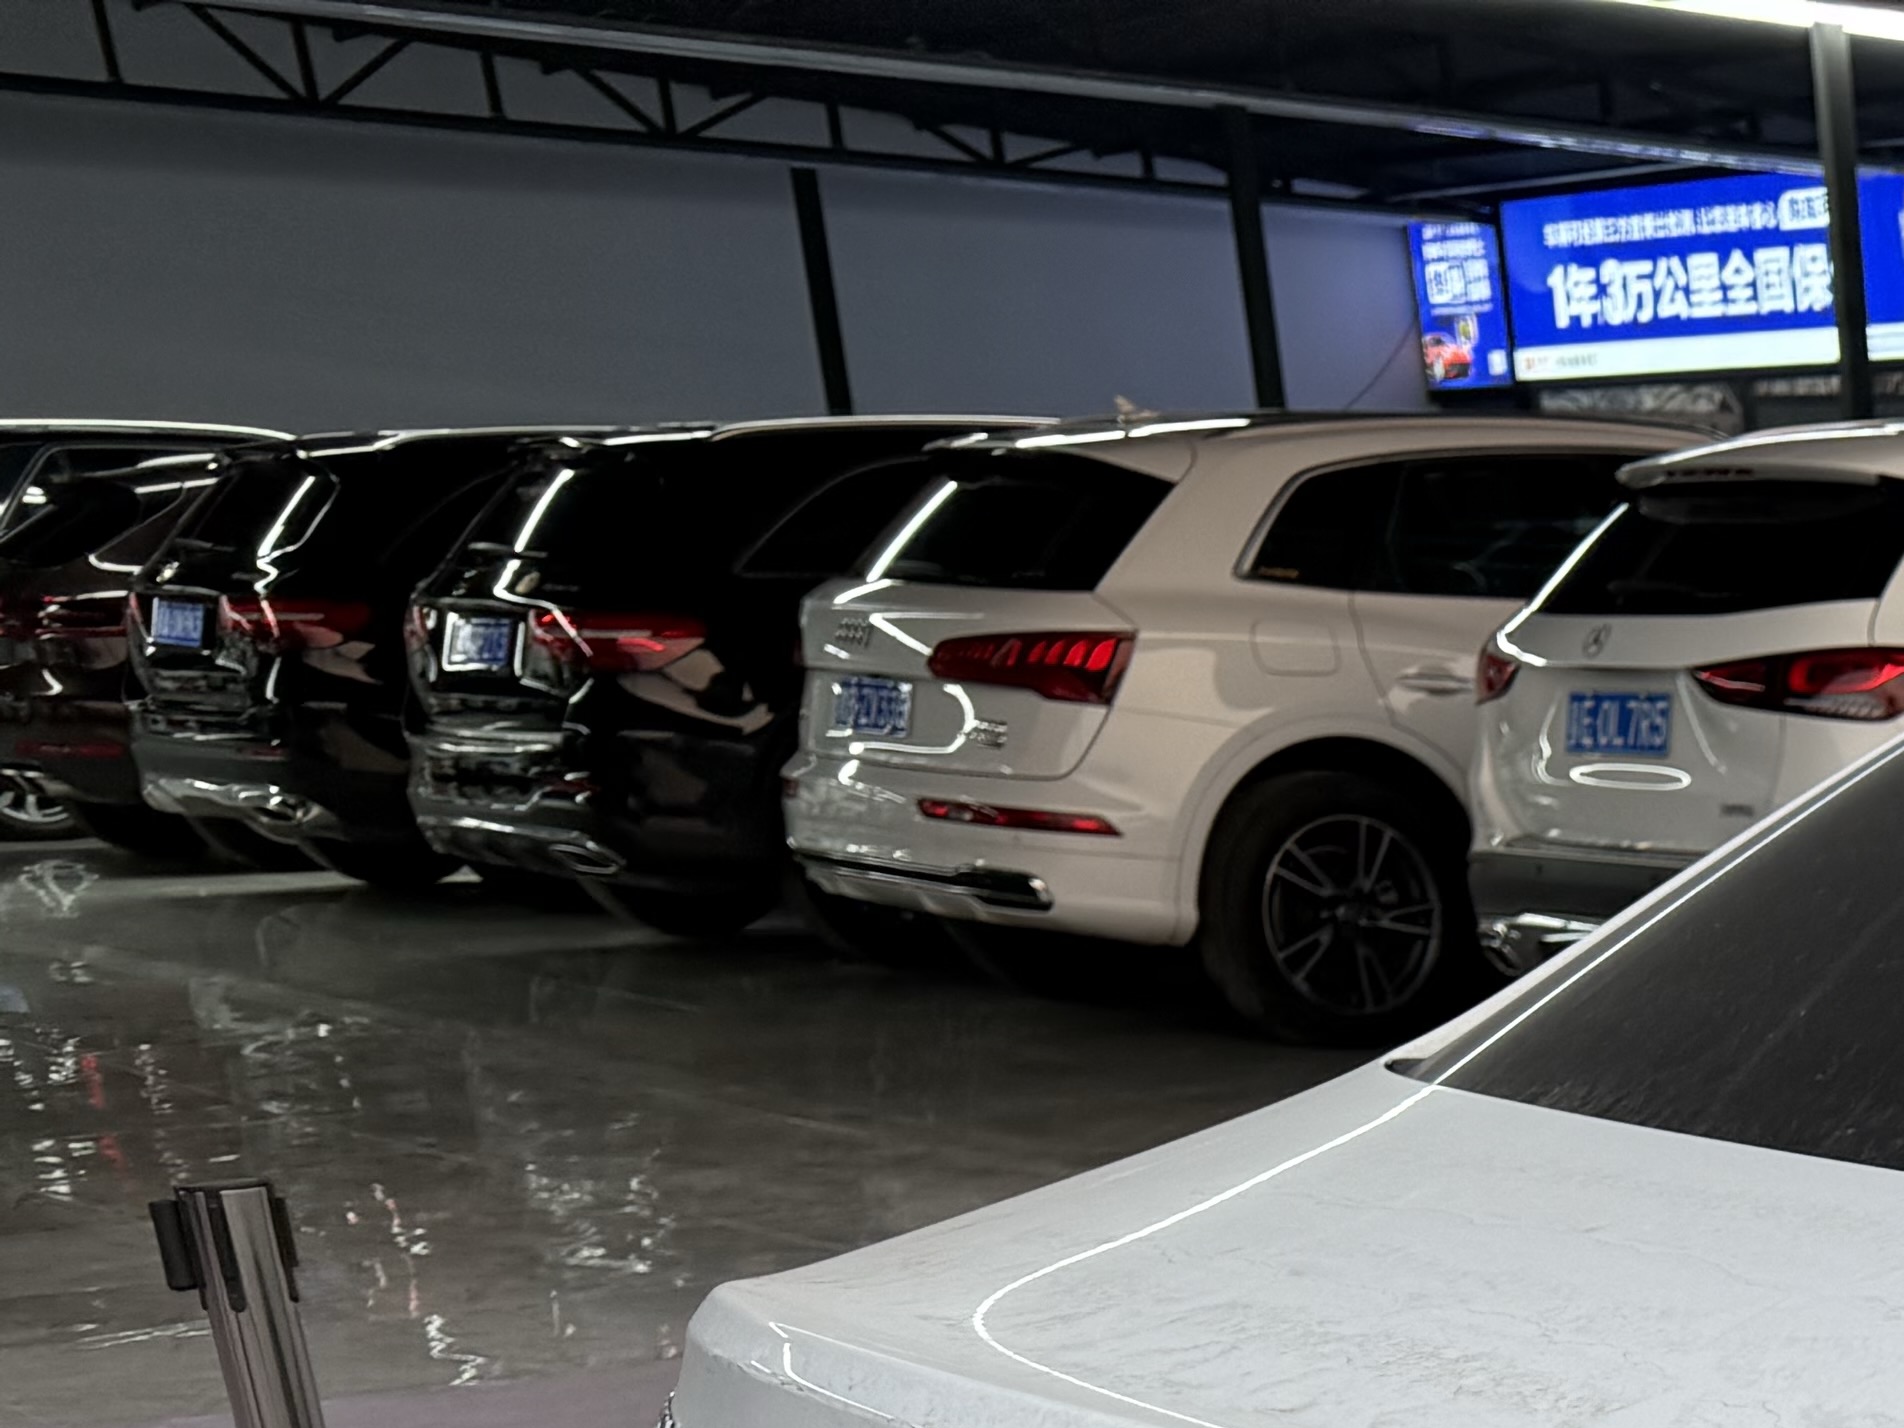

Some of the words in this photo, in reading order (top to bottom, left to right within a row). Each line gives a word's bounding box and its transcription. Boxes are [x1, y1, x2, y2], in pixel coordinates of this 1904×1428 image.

[1547, 243, 1835, 329] 1年3万公里全国保
